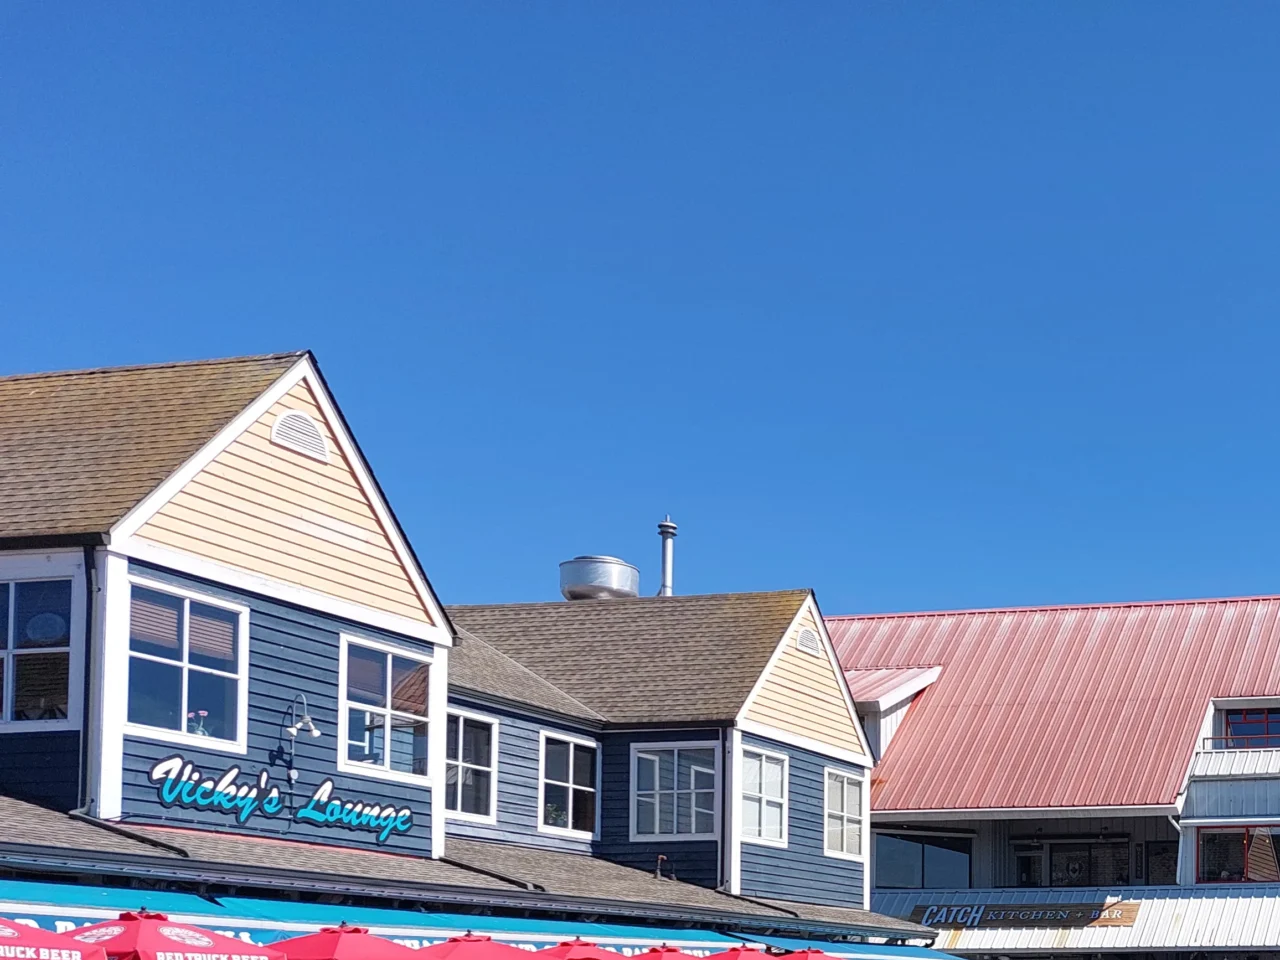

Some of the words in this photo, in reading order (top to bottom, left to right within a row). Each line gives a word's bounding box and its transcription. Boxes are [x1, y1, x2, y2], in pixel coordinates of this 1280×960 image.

[150, 754, 284, 823] Vicky's
[296, 779, 413, 842] Lounge
[921, 905, 985, 927] CATCH
[987, 910, 1069, 920] KITCHEN
[1090, 909, 1123, 920] BAR
